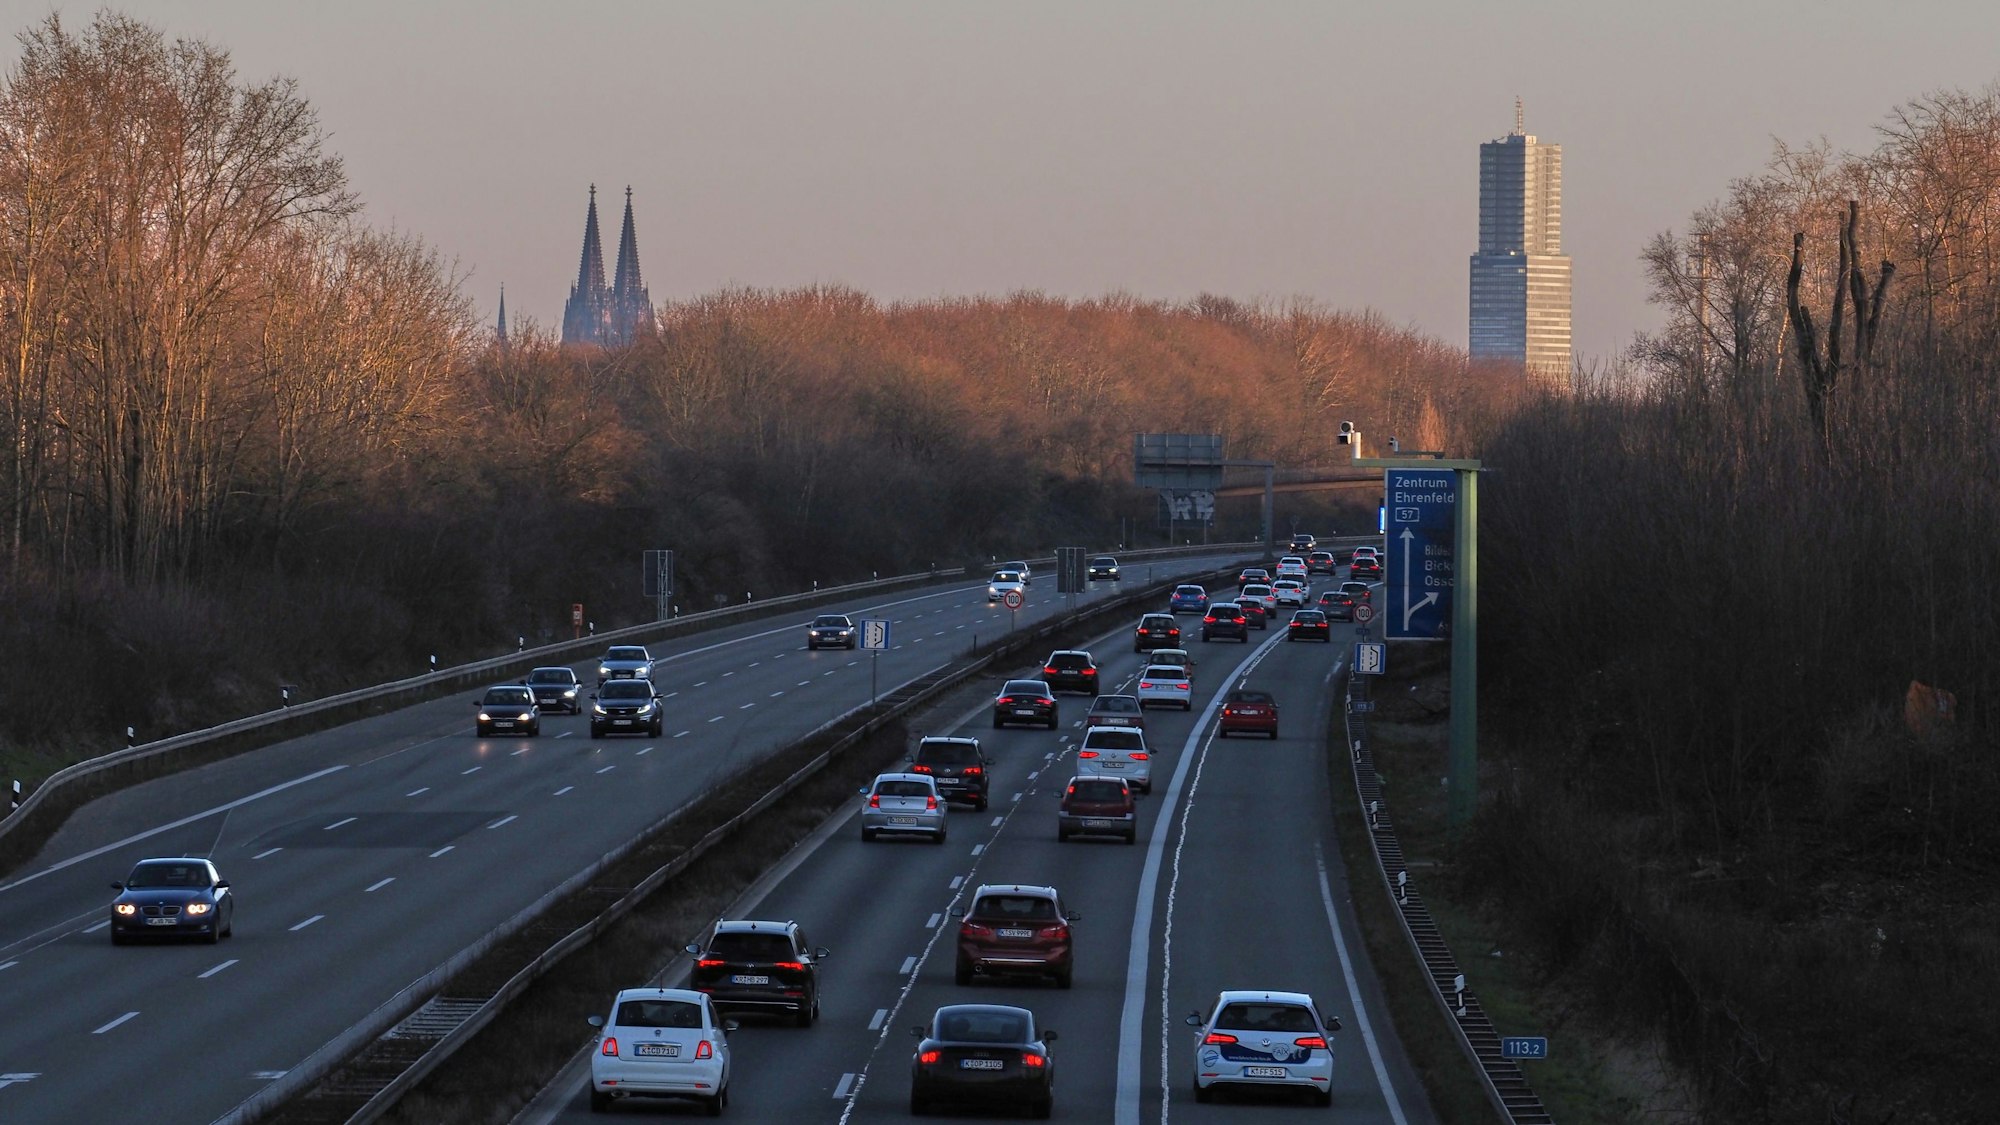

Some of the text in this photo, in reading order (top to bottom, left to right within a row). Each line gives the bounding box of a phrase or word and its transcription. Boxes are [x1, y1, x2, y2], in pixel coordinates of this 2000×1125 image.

[1395, 476, 1448, 488] Zentrum
[1395, 491, 1455, 503] Ehrenfeld
[1401, 510, 1414, 520] 57
[1007, 594, 1020, 605] 100
[1358, 608, 1370, 618] 100
[661, 1047, 675, 1055] 710
[1509, 1041, 1540, 1055] 113.2
[1269, 1068, 1283, 1076] 515
